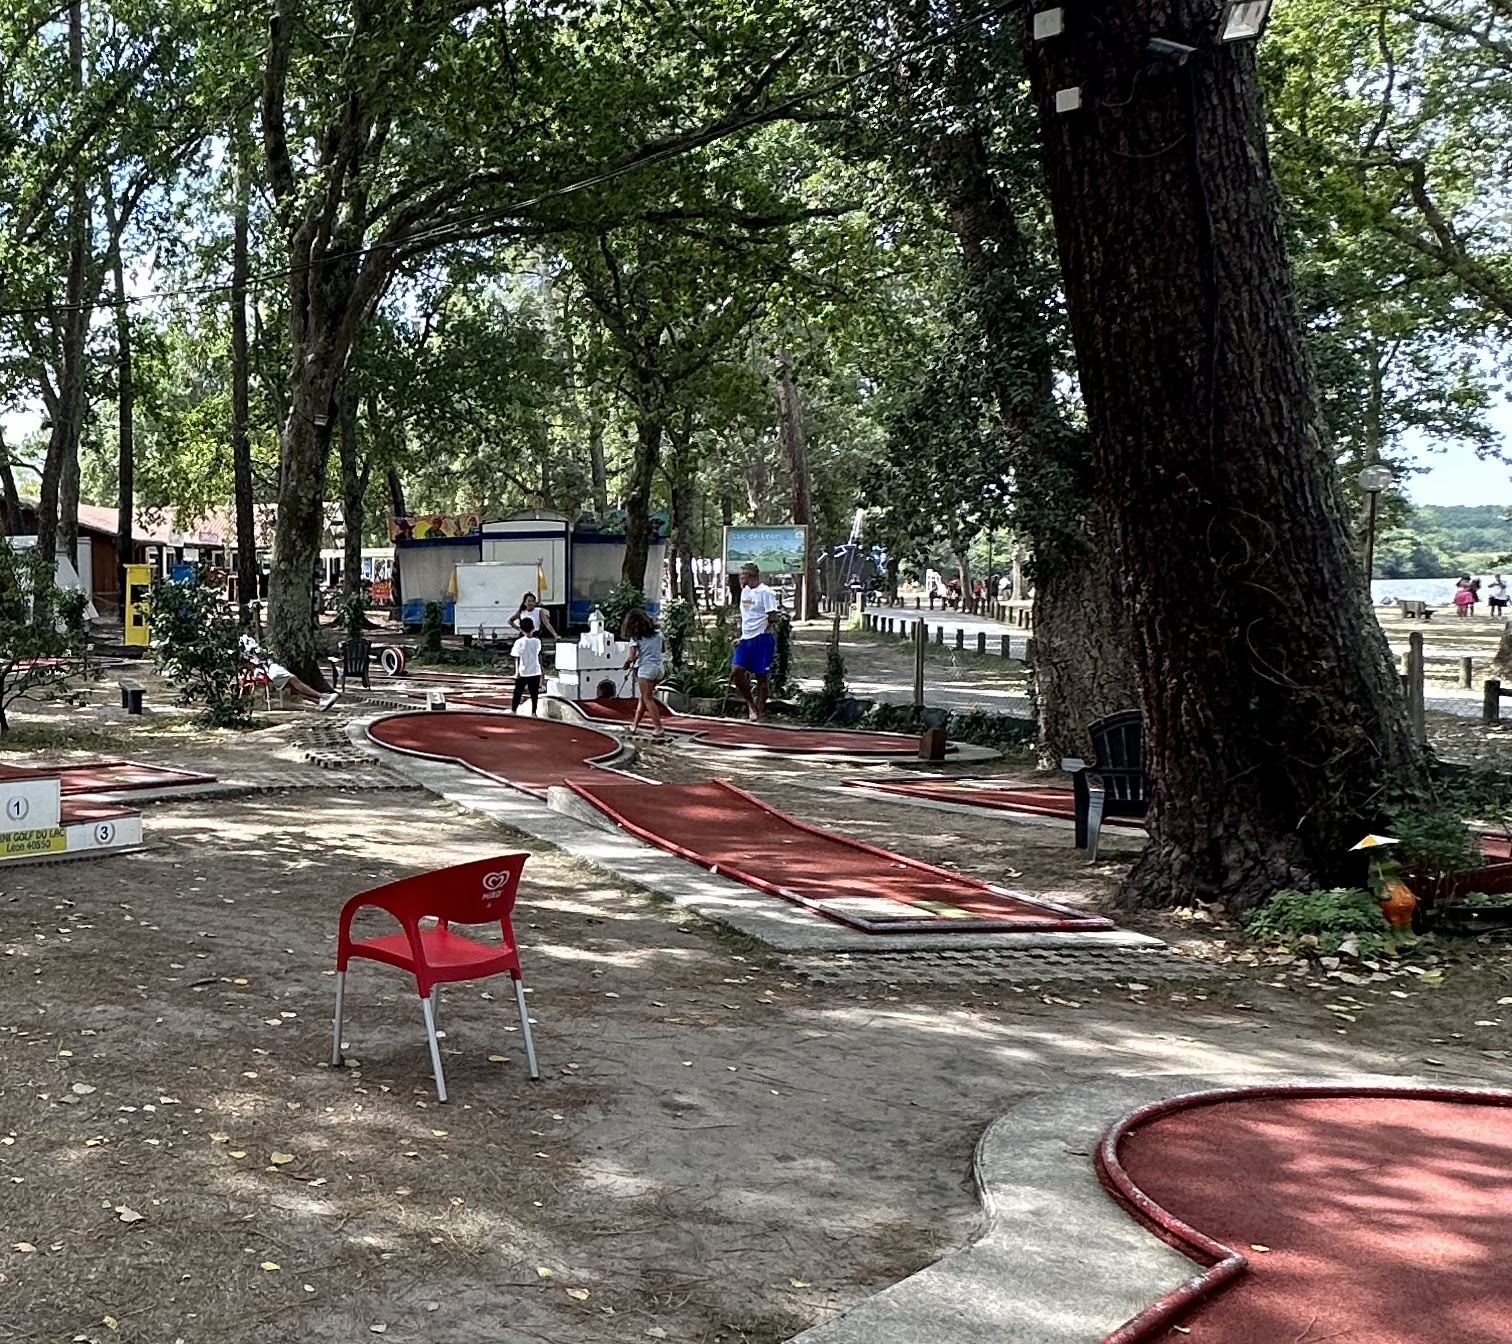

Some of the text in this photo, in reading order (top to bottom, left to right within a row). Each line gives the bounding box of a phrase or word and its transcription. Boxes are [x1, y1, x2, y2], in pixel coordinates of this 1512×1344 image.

[13, 801, 20, 816] 1
[13, 830, 35, 842] GOLF
[35, 829, 47, 839] DU
[49, 828, 65, 838] LAC
[100, 825, 109, 840] 3
